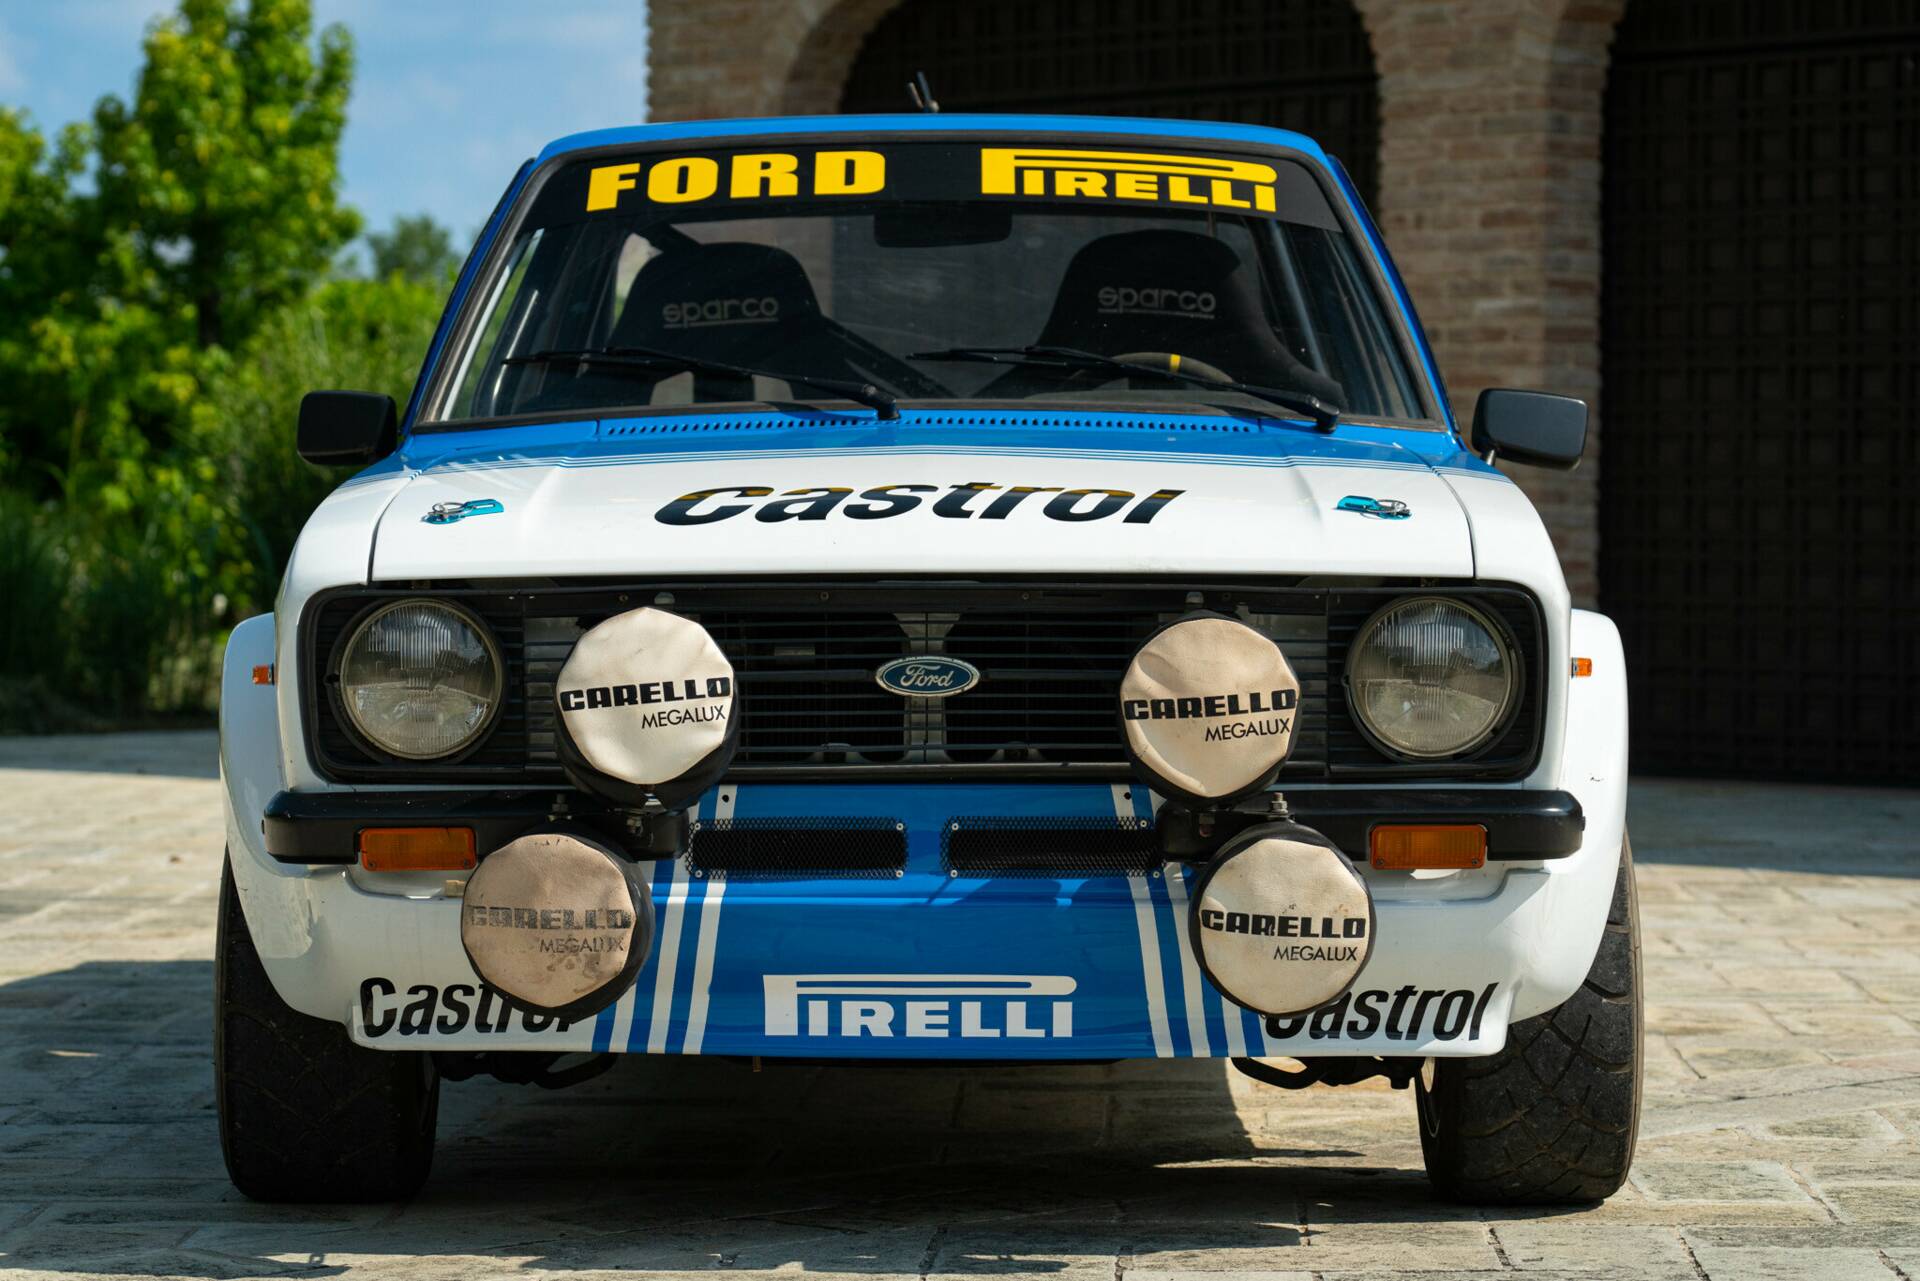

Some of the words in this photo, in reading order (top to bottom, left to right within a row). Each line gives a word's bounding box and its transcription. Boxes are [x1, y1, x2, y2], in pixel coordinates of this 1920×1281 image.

[587, 150, 885, 212] FORD
[980, 148, 1277, 213] PIRELLI
[661, 295, 779, 328] sparco
[1097, 285, 1216, 314] sparco
[654, 482, 1186, 525] Castrol
[900, 664, 954, 687] Ford
[559, 677, 731, 712] CARELLO
[1124, 689, 1297, 720] CARELLO
[641, 705, 726, 729] MEGALUX
[1205, 718, 1290, 742] MEGALUX
[1201, 909, 1366, 939] CARELLO
[1273, 945, 1358, 961] MEGALUX
[762, 974, 1077, 1038] PIRELLI
